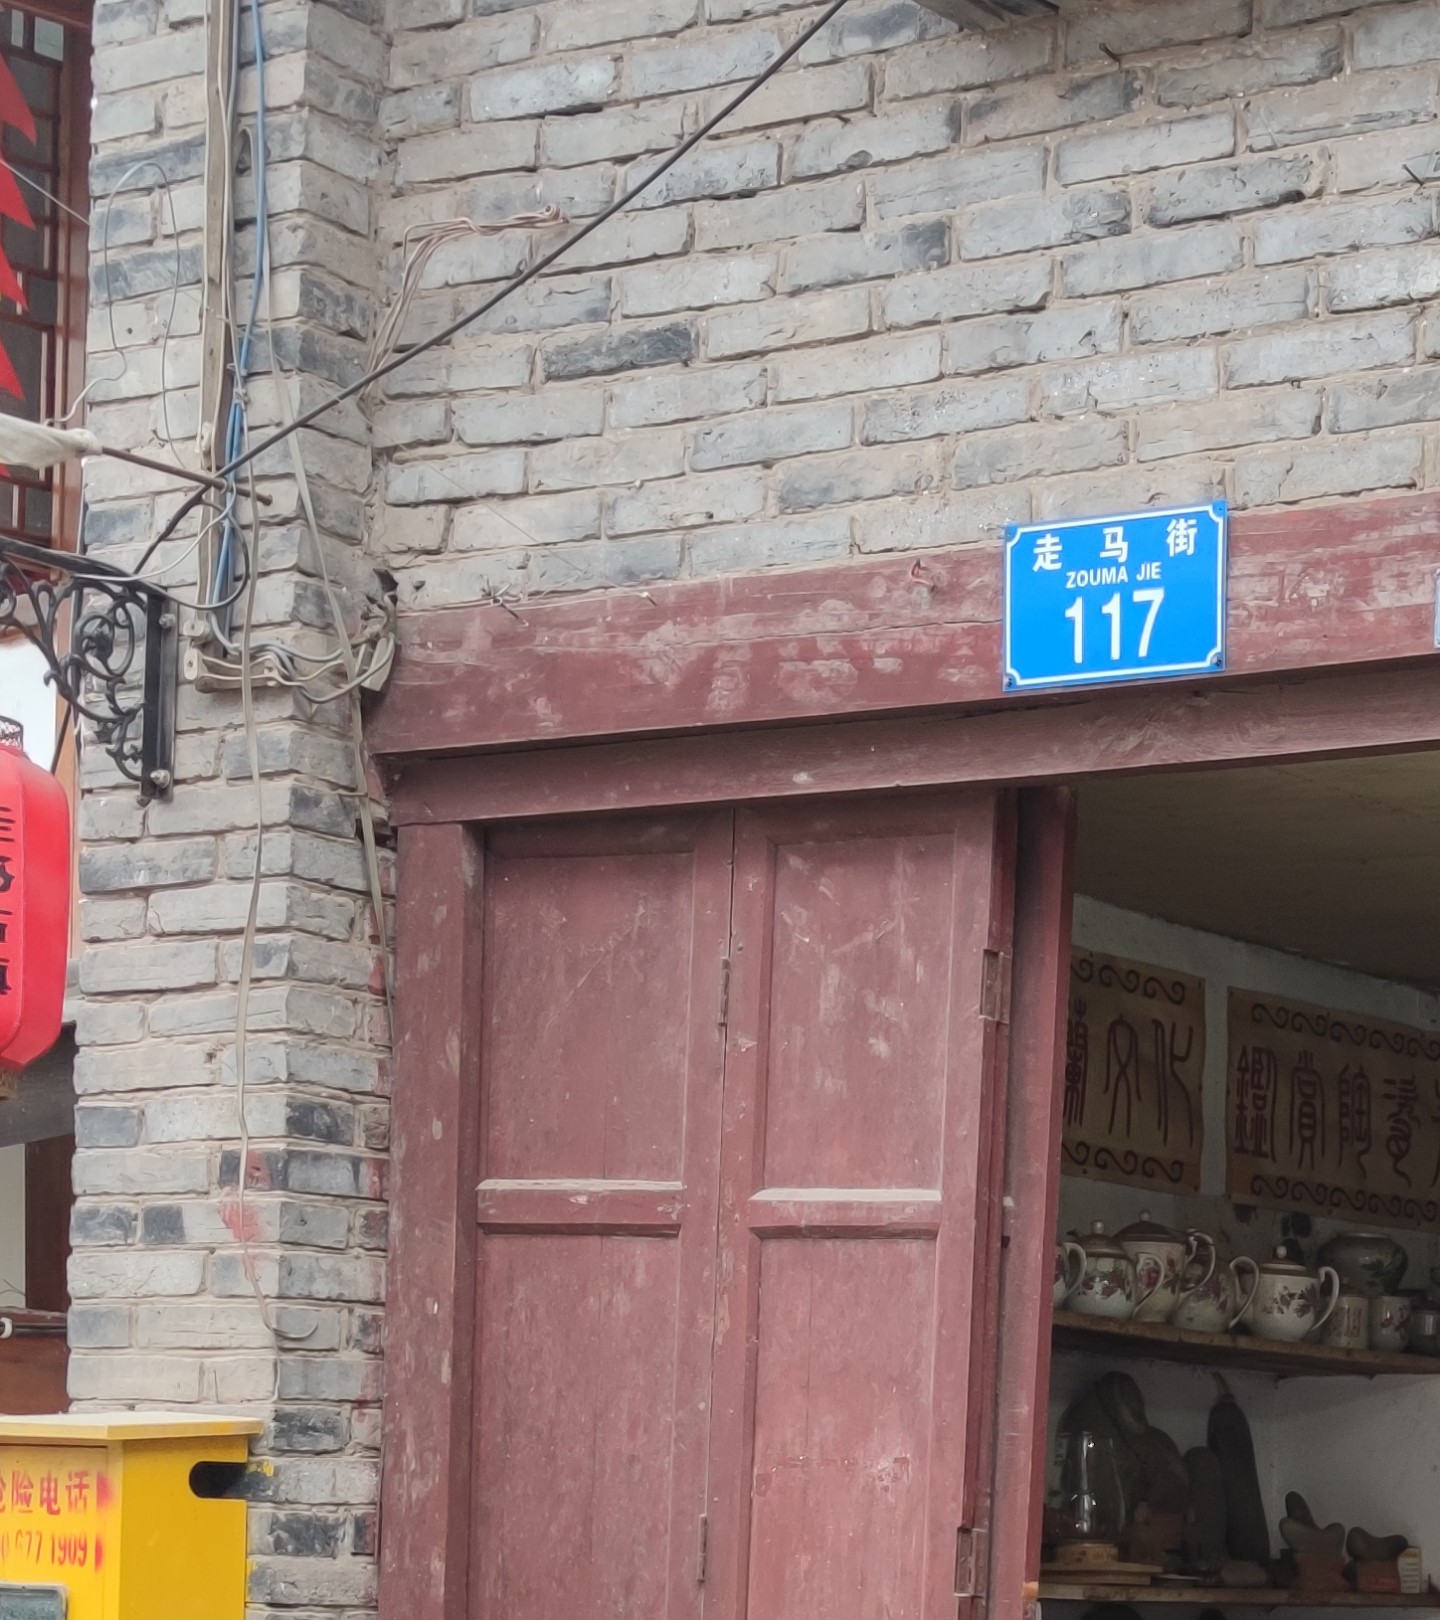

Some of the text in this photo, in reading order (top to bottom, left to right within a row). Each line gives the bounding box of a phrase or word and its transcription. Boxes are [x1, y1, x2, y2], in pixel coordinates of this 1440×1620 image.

[1032, 517, 1198, 573] 走马街
[1066, 561, 1163, 590] ZOUMA JIE
[1065, 588, 1166, 665] 117
[50, 1532, 89, 1567] 1909
